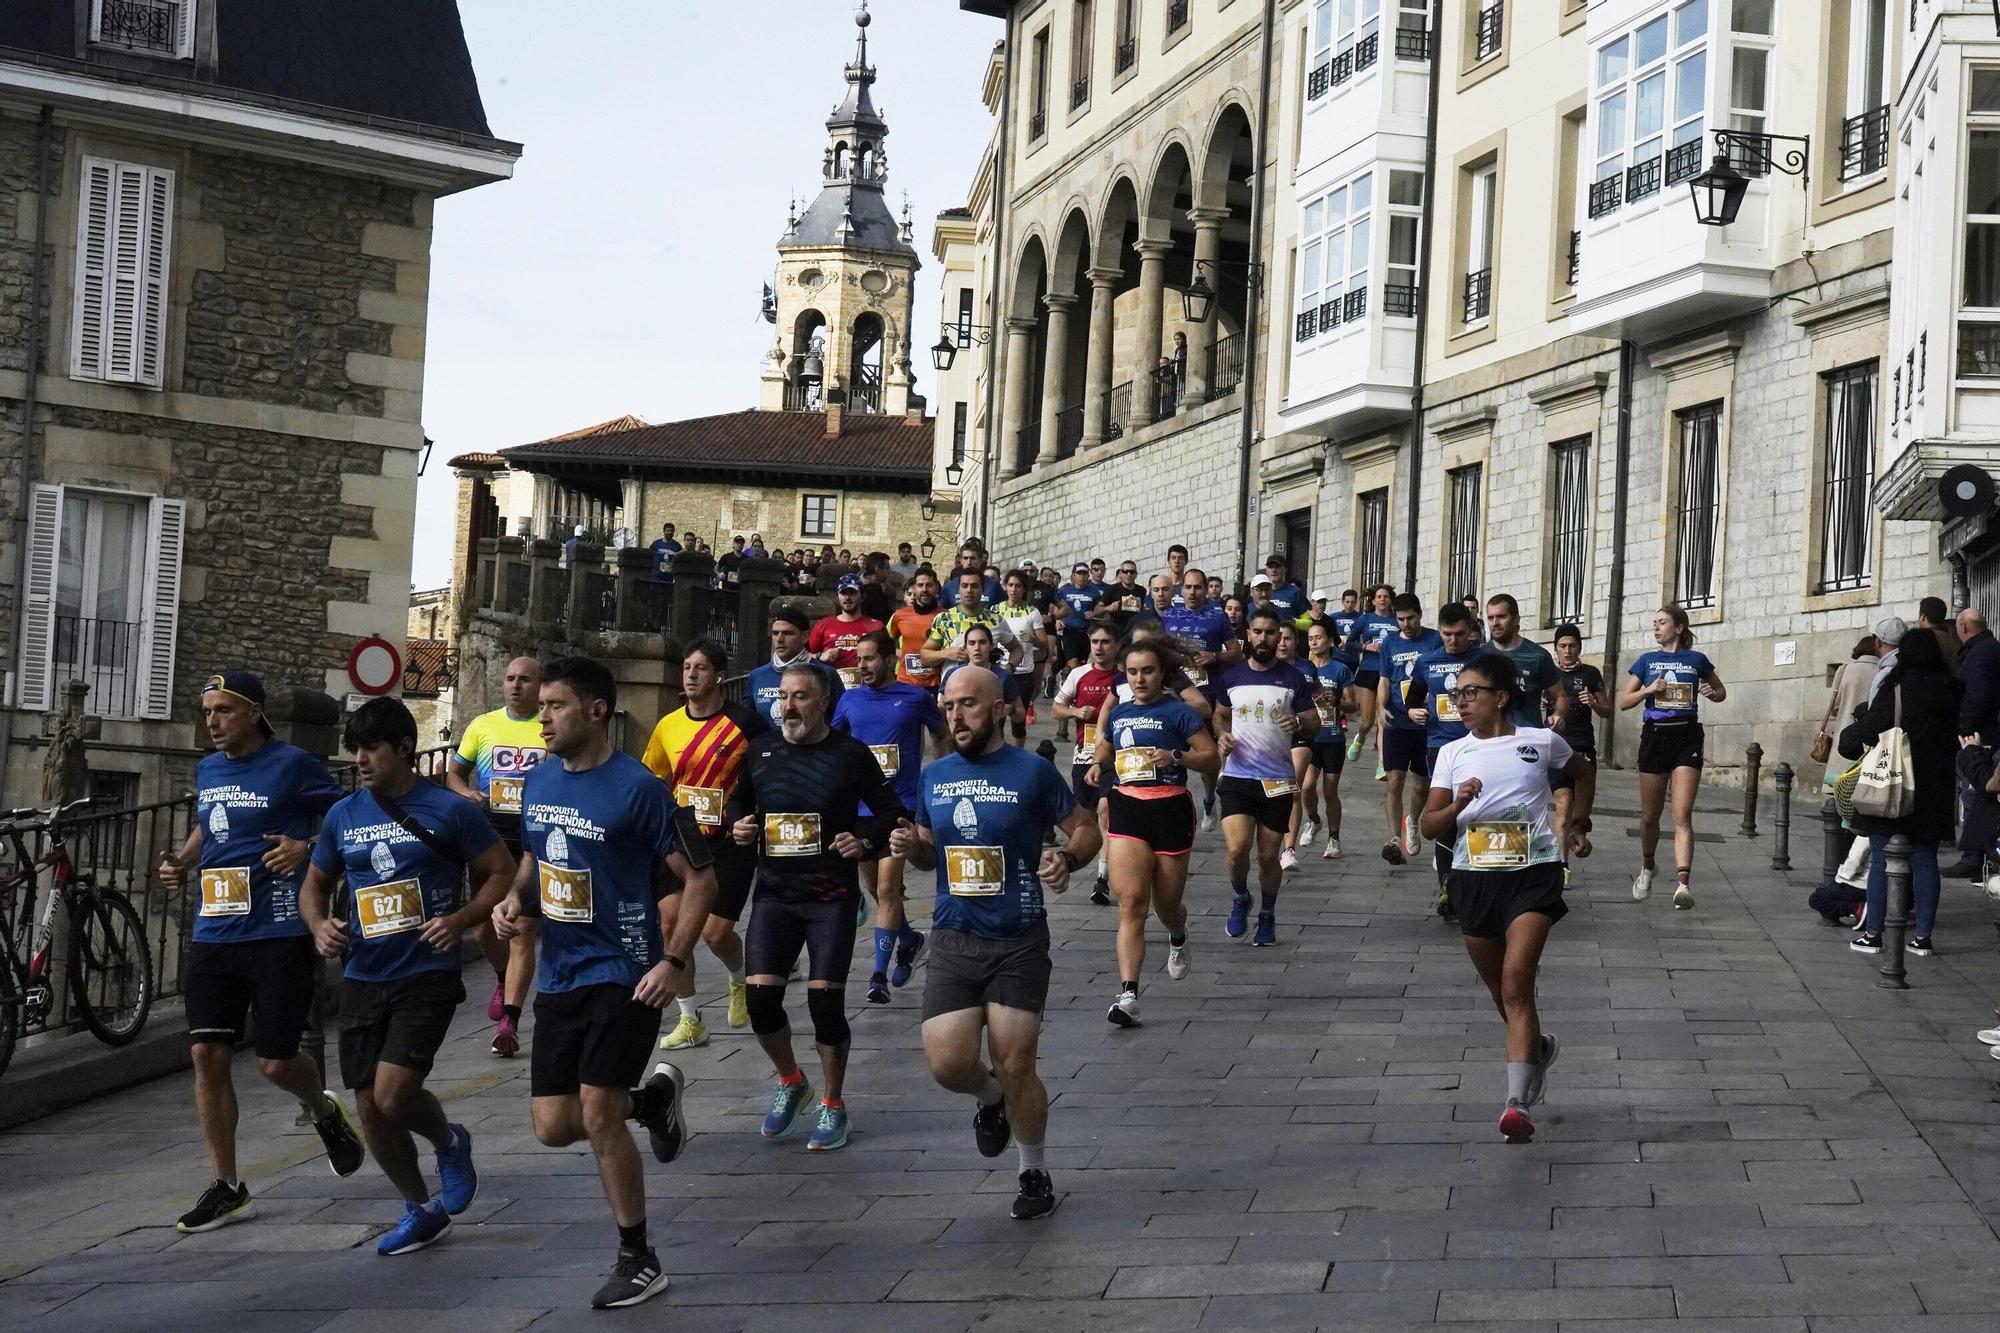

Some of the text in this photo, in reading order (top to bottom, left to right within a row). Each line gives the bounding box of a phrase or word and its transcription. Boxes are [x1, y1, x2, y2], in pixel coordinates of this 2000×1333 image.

[204, 785, 241, 796] CONQUISTA
[942, 779, 988, 789] CONQUISTA
[202, 792, 256, 803] ALMENDRA
[942, 786, 1006, 798] ALMENDRA
[974, 795, 1018, 804] KONKISTA
[535, 804, 579, 816] CONQUISTA
[688, 795, 709, 810] 553
[535, 813, 592, 831] ALMENDRA
[566, 827, 605, 842] KONKISTA
[778, 823, 804, 840] 154
[1488, 833, 1507, 849] 27
[960, 858, 984, 877] 181
[214, 880, 230, 897] 81
[548, 878, 572, 902] 404
[373, 894, 403, 917] 627
